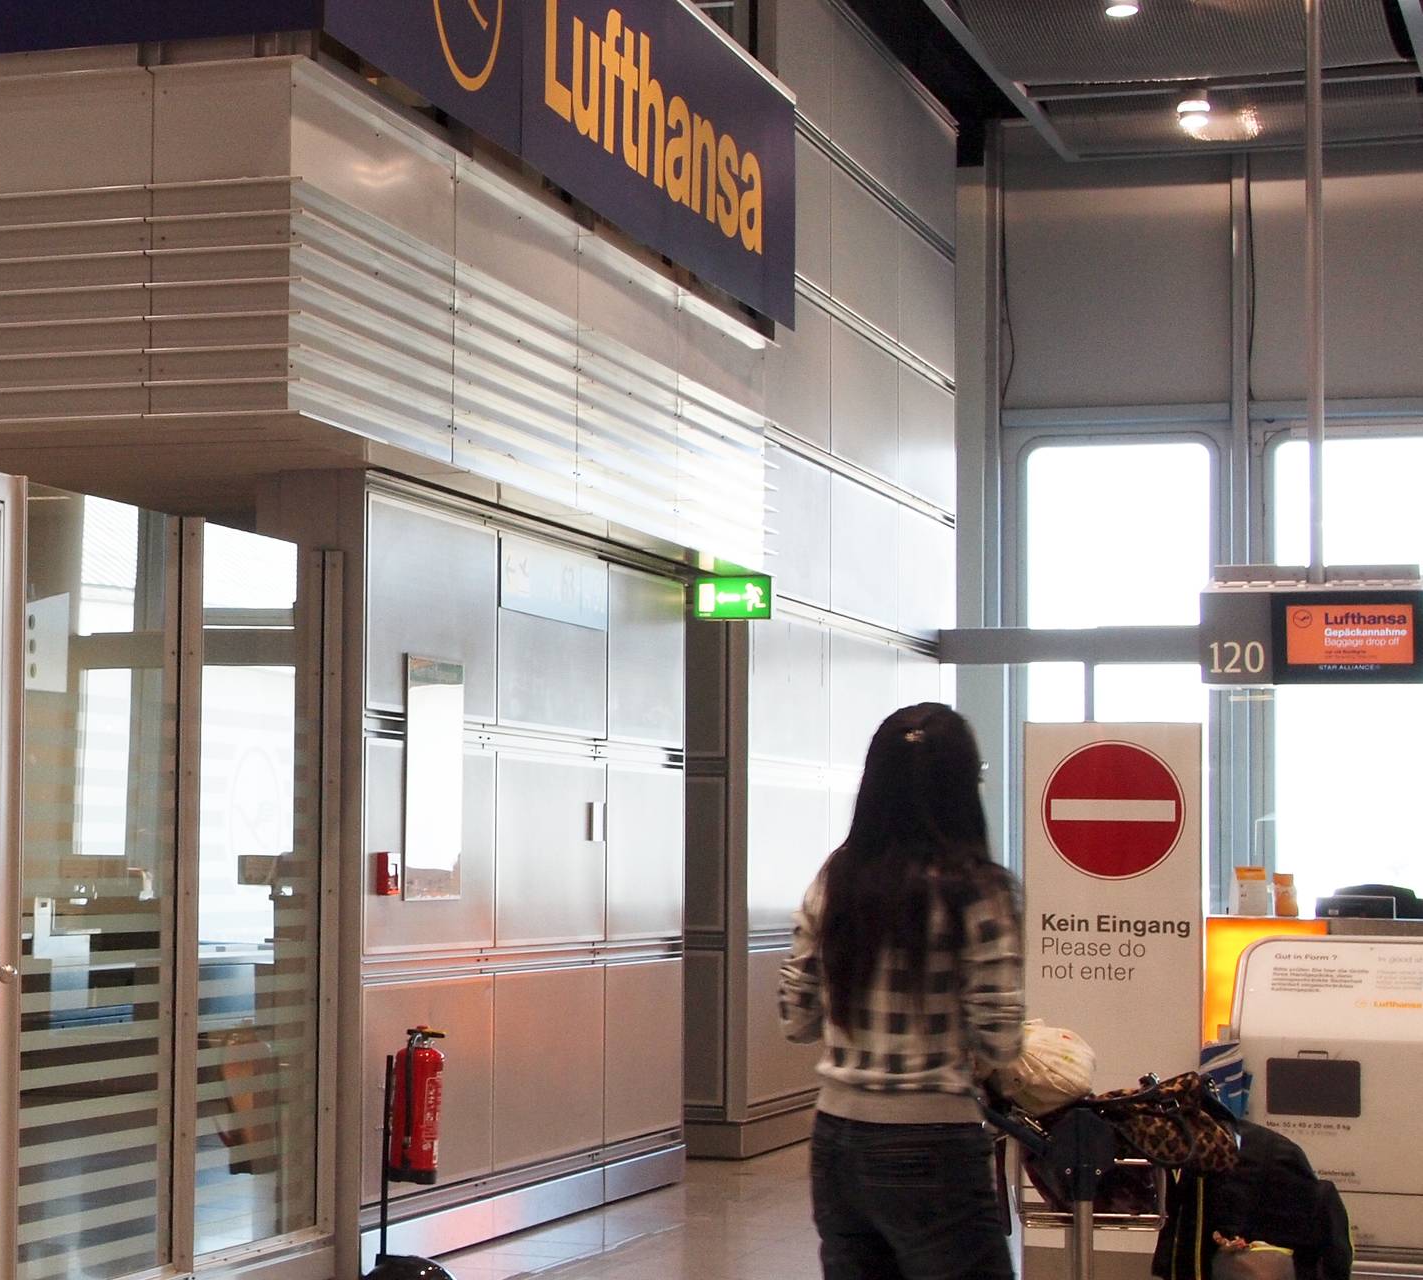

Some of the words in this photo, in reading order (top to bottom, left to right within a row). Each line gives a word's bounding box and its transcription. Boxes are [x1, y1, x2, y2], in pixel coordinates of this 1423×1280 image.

[545, 0, 763, 255] Lufthansa
[1324, 613, 1407, 625] Lufthansa
[1324, 628, 1407, 638] Gepäckannahme
[1324, 638, 1364, 648] Baggage
[1366, 638, 1386, 647] drop
[1388, 638, 1400, 646] off
[1209, 641, 1265, 674] 120
[1041, 913, 1090, 932] Kein
[1096, 914, 1191, 938] Eingang
[1041, 936, 1112, 956] Please
[1118, 939, 1146, 958] do
[1274, 953, 1292, 961] Gut
[1293, 953, 1303, 961] in
[1304, 953, 1329, 962] Form
[1041, 962, 1074, 979] not
[1080, 963, 1135, 981] enter
